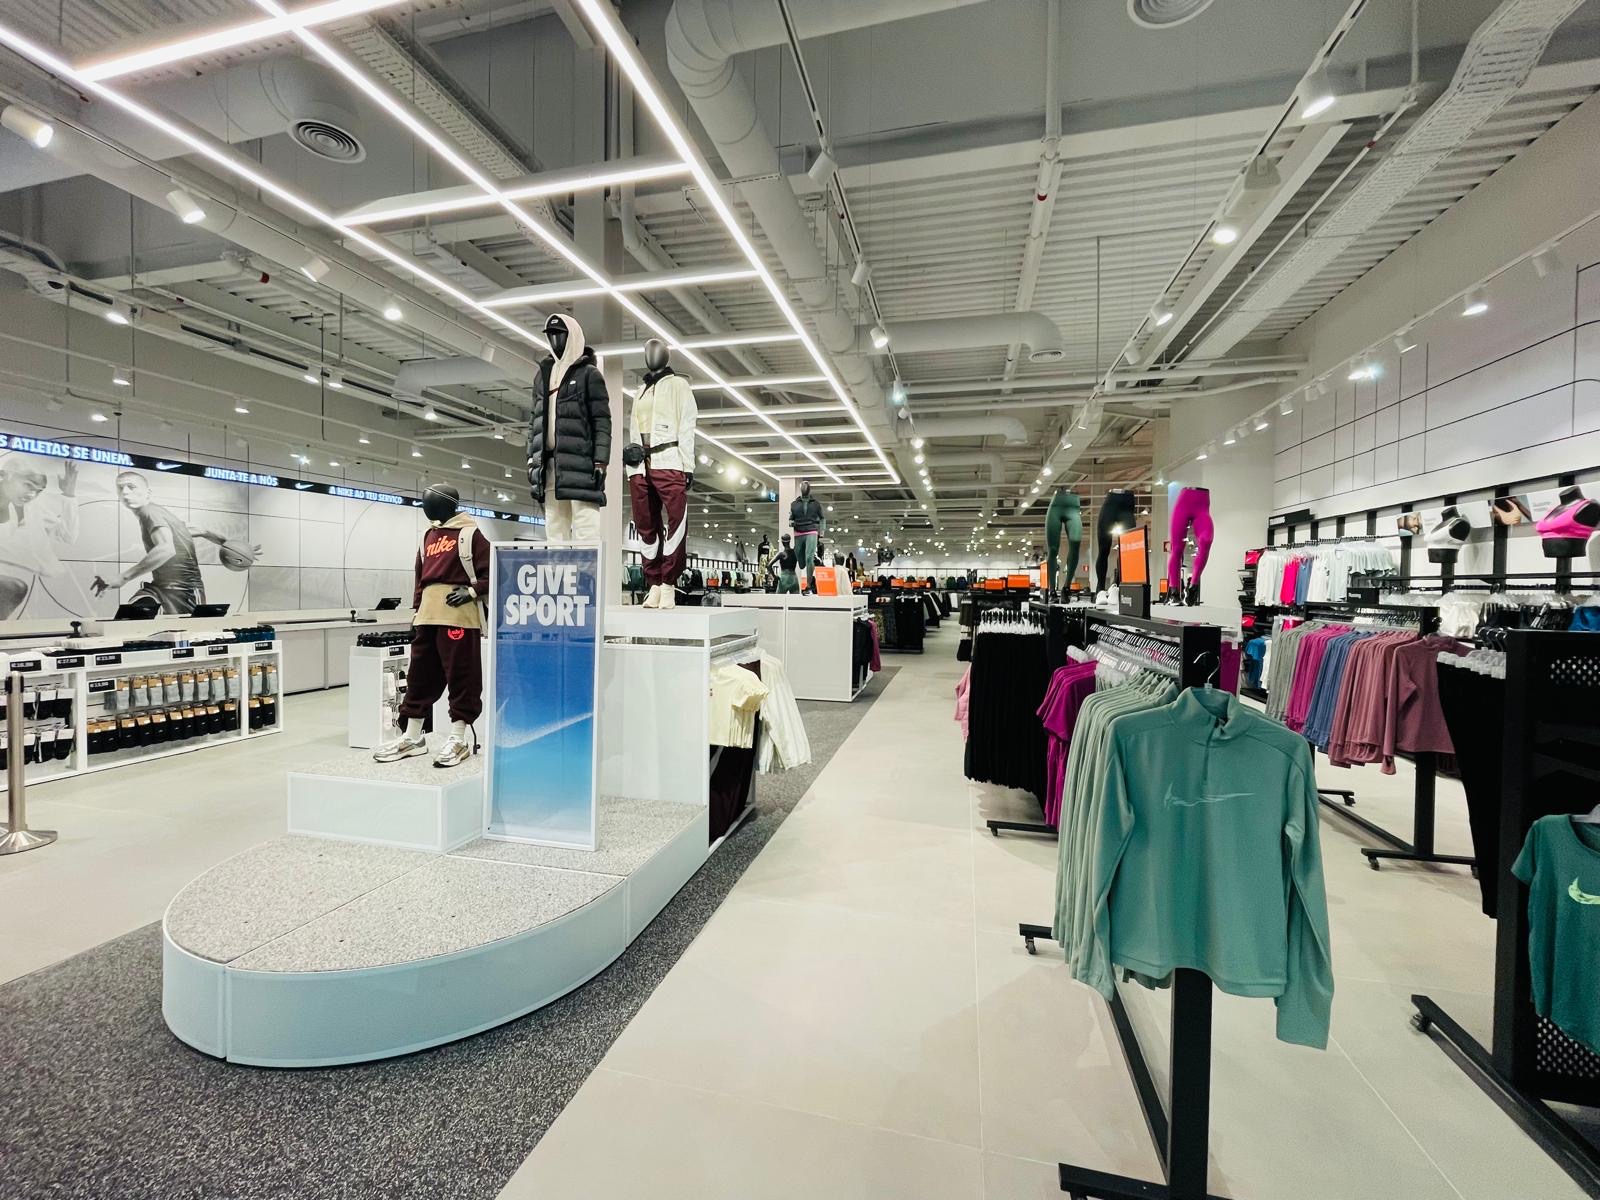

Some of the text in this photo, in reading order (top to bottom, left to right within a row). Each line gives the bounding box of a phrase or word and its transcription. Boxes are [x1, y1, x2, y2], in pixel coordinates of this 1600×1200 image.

[12, 436, 70, 458] ATLETAS
[73, 446, 89, 460] SE
[92, 449, 135, 466] UNEM.
[204, 467, 248, 483] JUNTA-TE
[249, 474, 257, 484] A
[427, 535, 457, 557] nike
[517, 564, 577, 594] GIVE
[505, 594, 590, 627] SPORT
